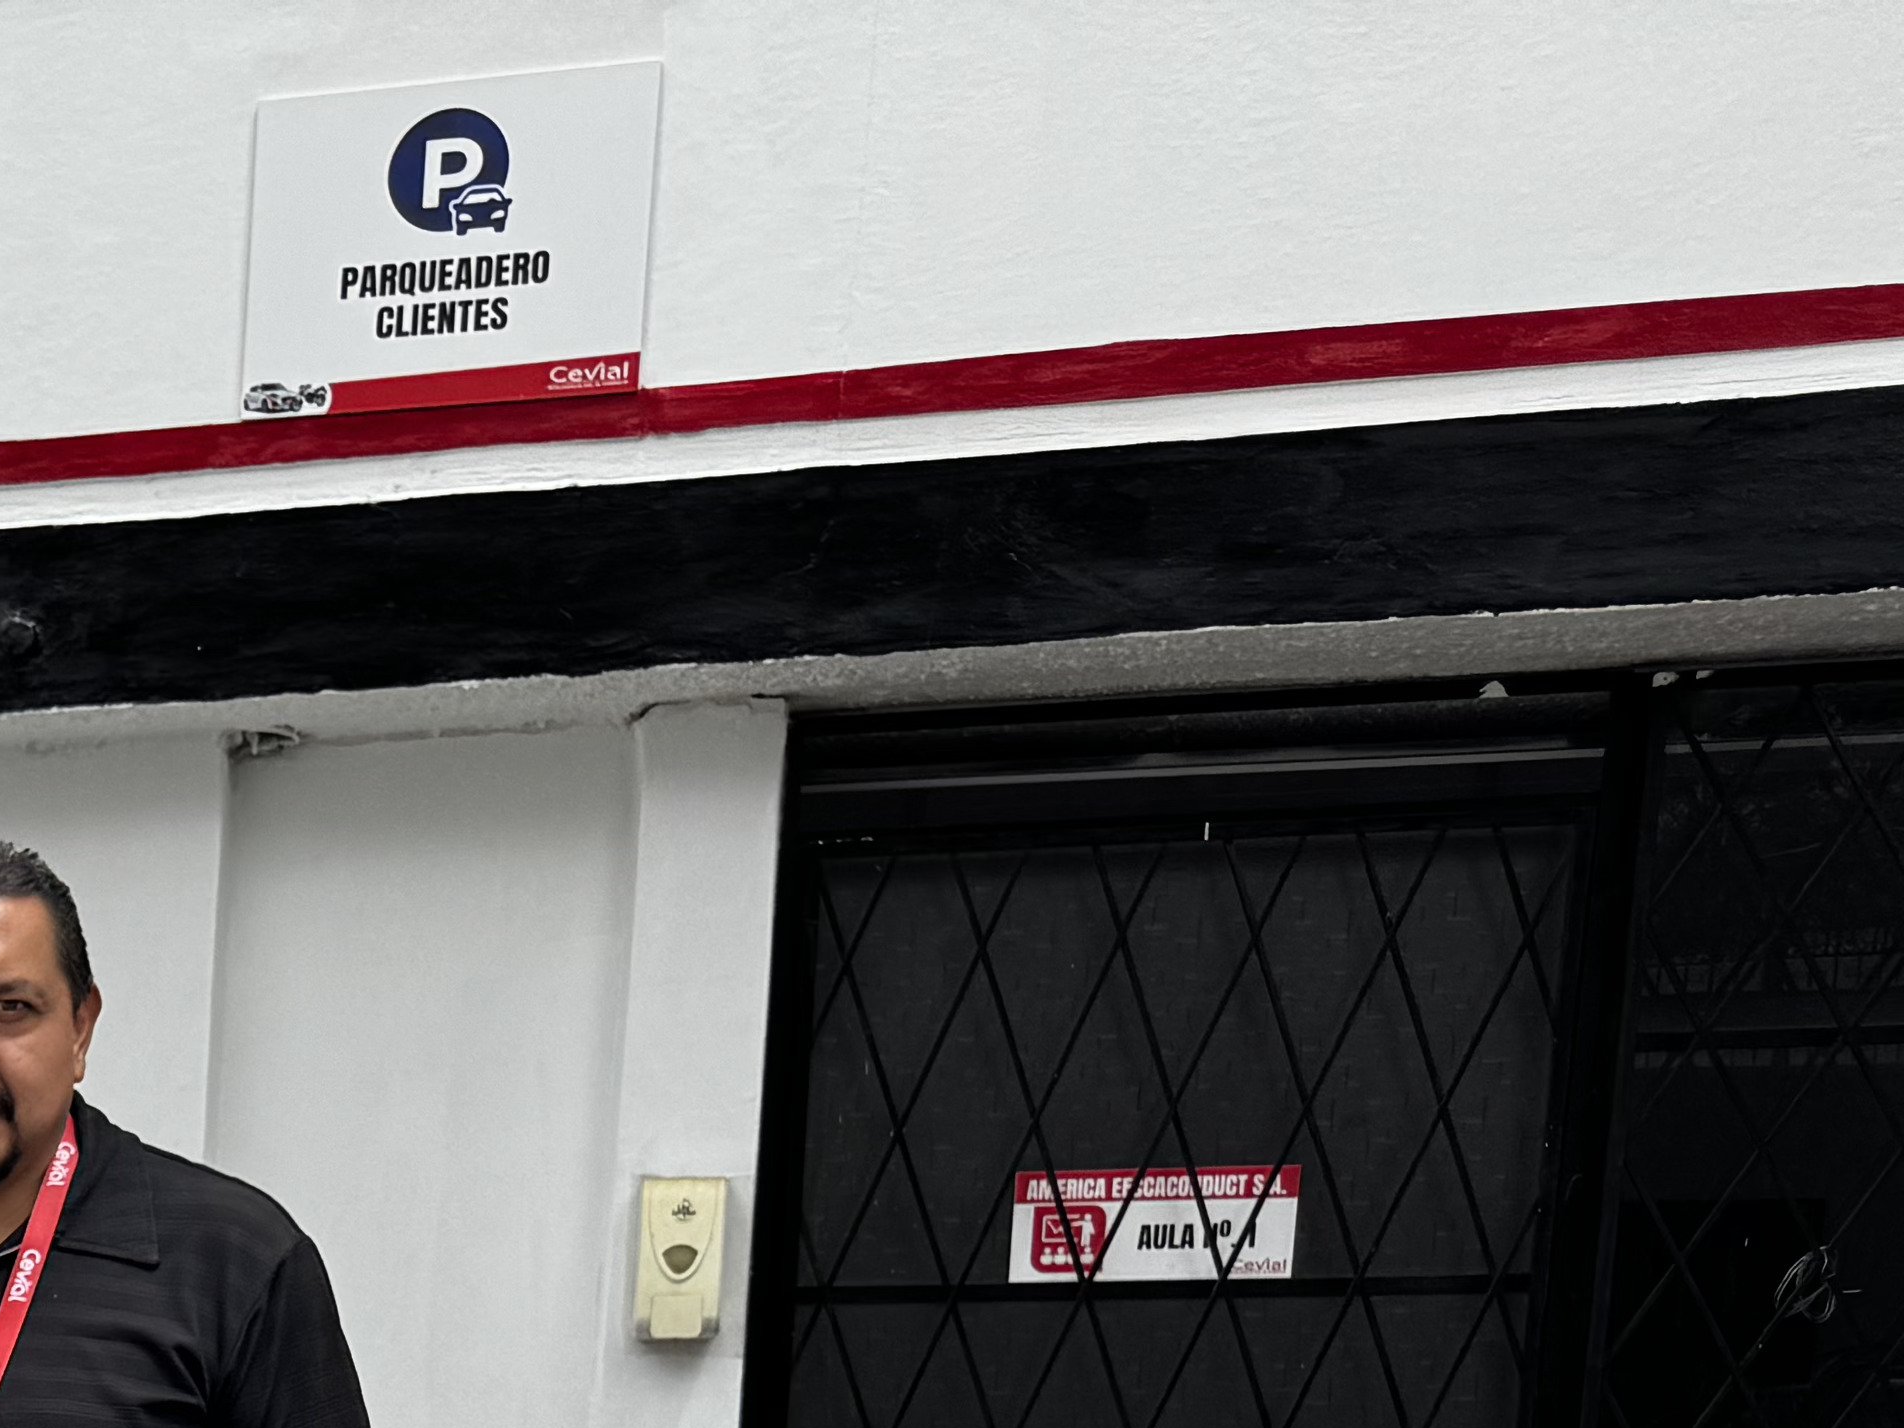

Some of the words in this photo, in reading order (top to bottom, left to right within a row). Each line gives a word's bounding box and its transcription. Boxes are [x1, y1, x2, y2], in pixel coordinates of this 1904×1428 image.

[421, 136, 485, 210] P
[339, 250, 551, 300] PARQUEADERO
[376, 297, 509, 340] CLIENTES
[1137, 1223, 1195, 1250] AULA
[7, 1248, 42, 1303] Cevial
